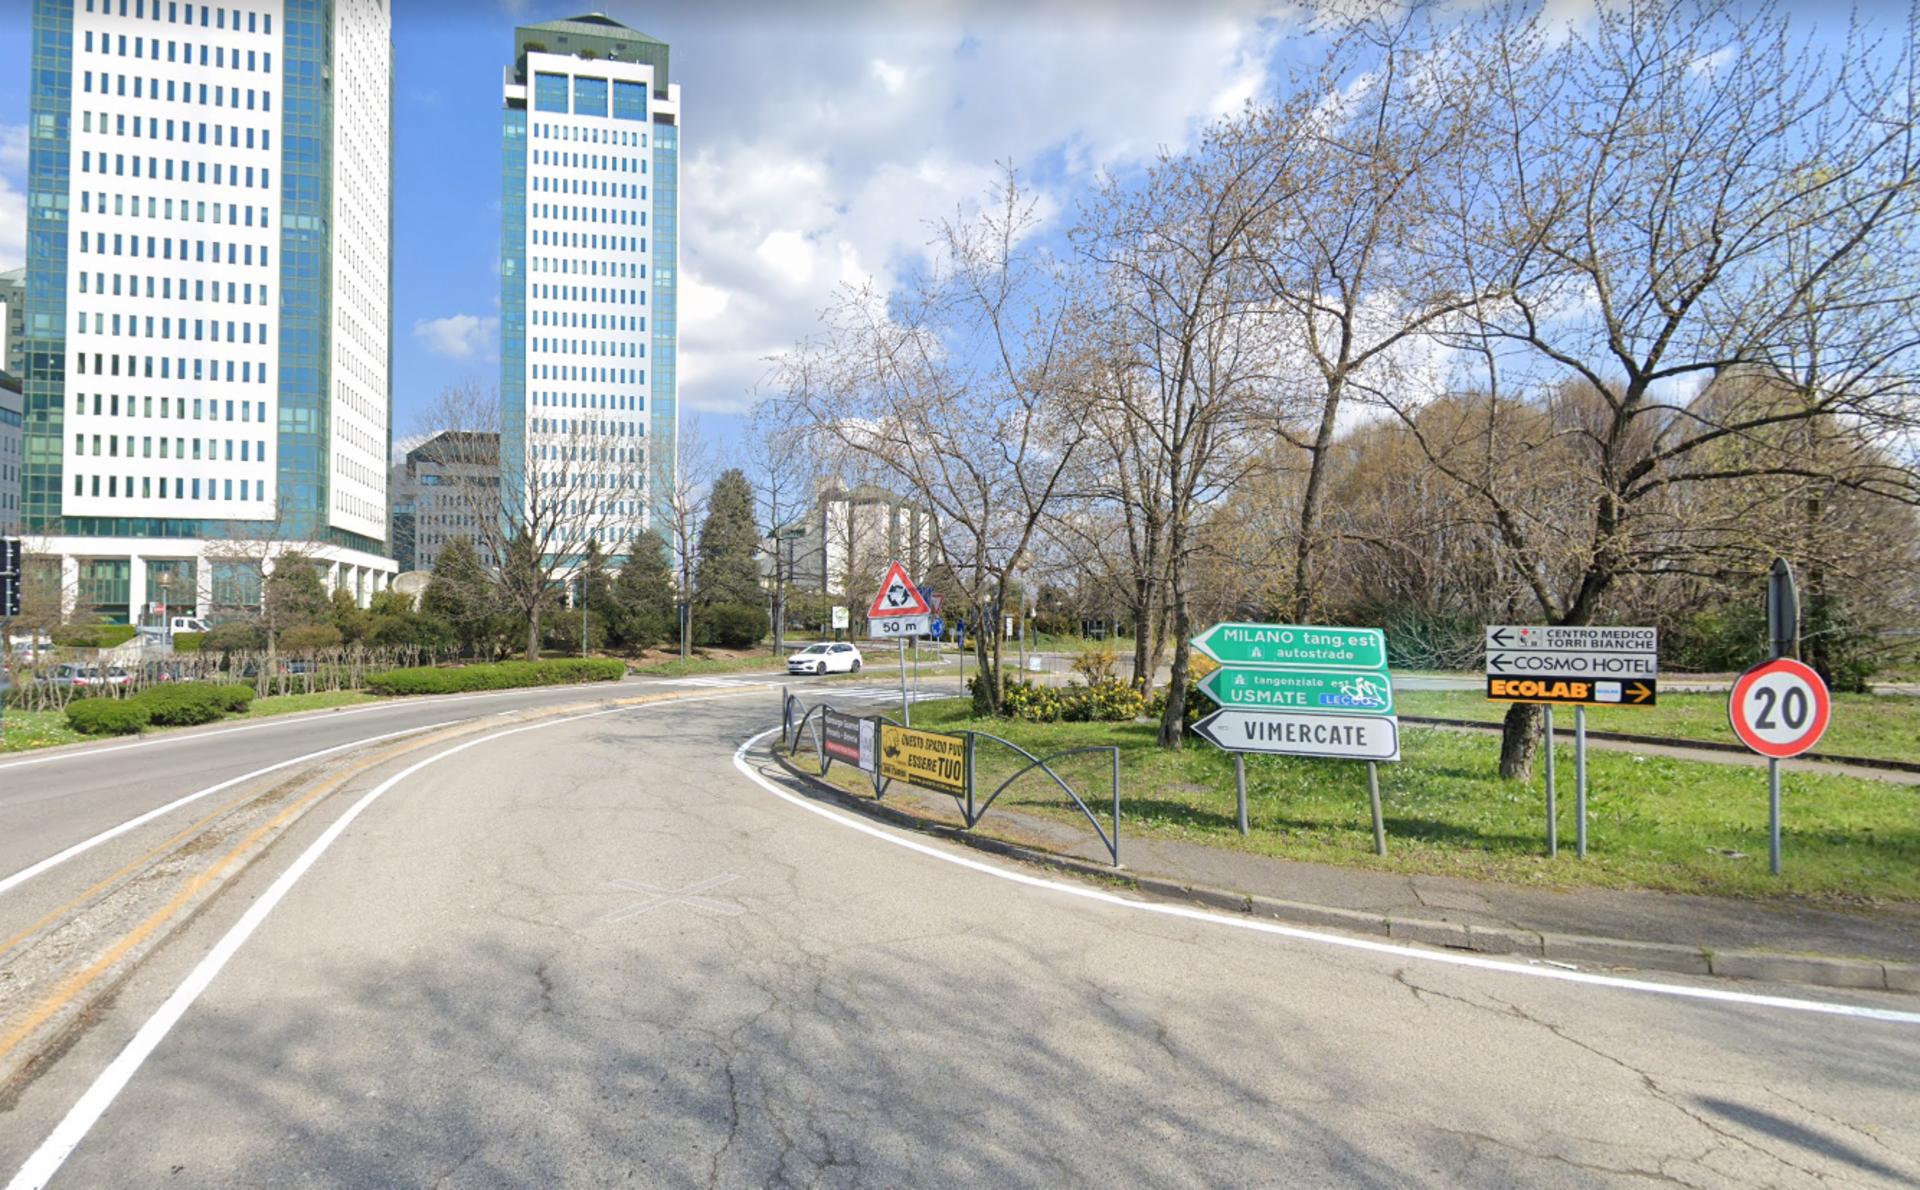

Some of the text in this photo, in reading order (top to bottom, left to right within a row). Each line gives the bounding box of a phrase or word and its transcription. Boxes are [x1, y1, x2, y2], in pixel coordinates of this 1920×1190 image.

[883, 622, 917, 633] 50 m
[1546, 629, 1654, 640] CENTRO MEDICO
[1224, 629, 1294, 644] MILANO
[1348, 634, 1376, 647] est
[1547, 639, 1654, 649] TORRI BIANCHE
[1277, 648, 1355, 660] autostrade
[1514, 656, 1653, 673] COSMO HOTEL
[1254, 676, 1324, 687] tangenziale
[1491, 679, 1589, 698] ECOLAB
[1231, 689, 1369, 705] USMATE LECCO
[1754, 686, 1808, 730] 20
[1244, 721, 1368, 746] VIMERCATE
[902, 734, 924, 749] QUESTO
[925, 738, 947, 753] SPAZIO
[908, 754, 937, 773] ESSERE
[937, 757, 961, 781] TUO
